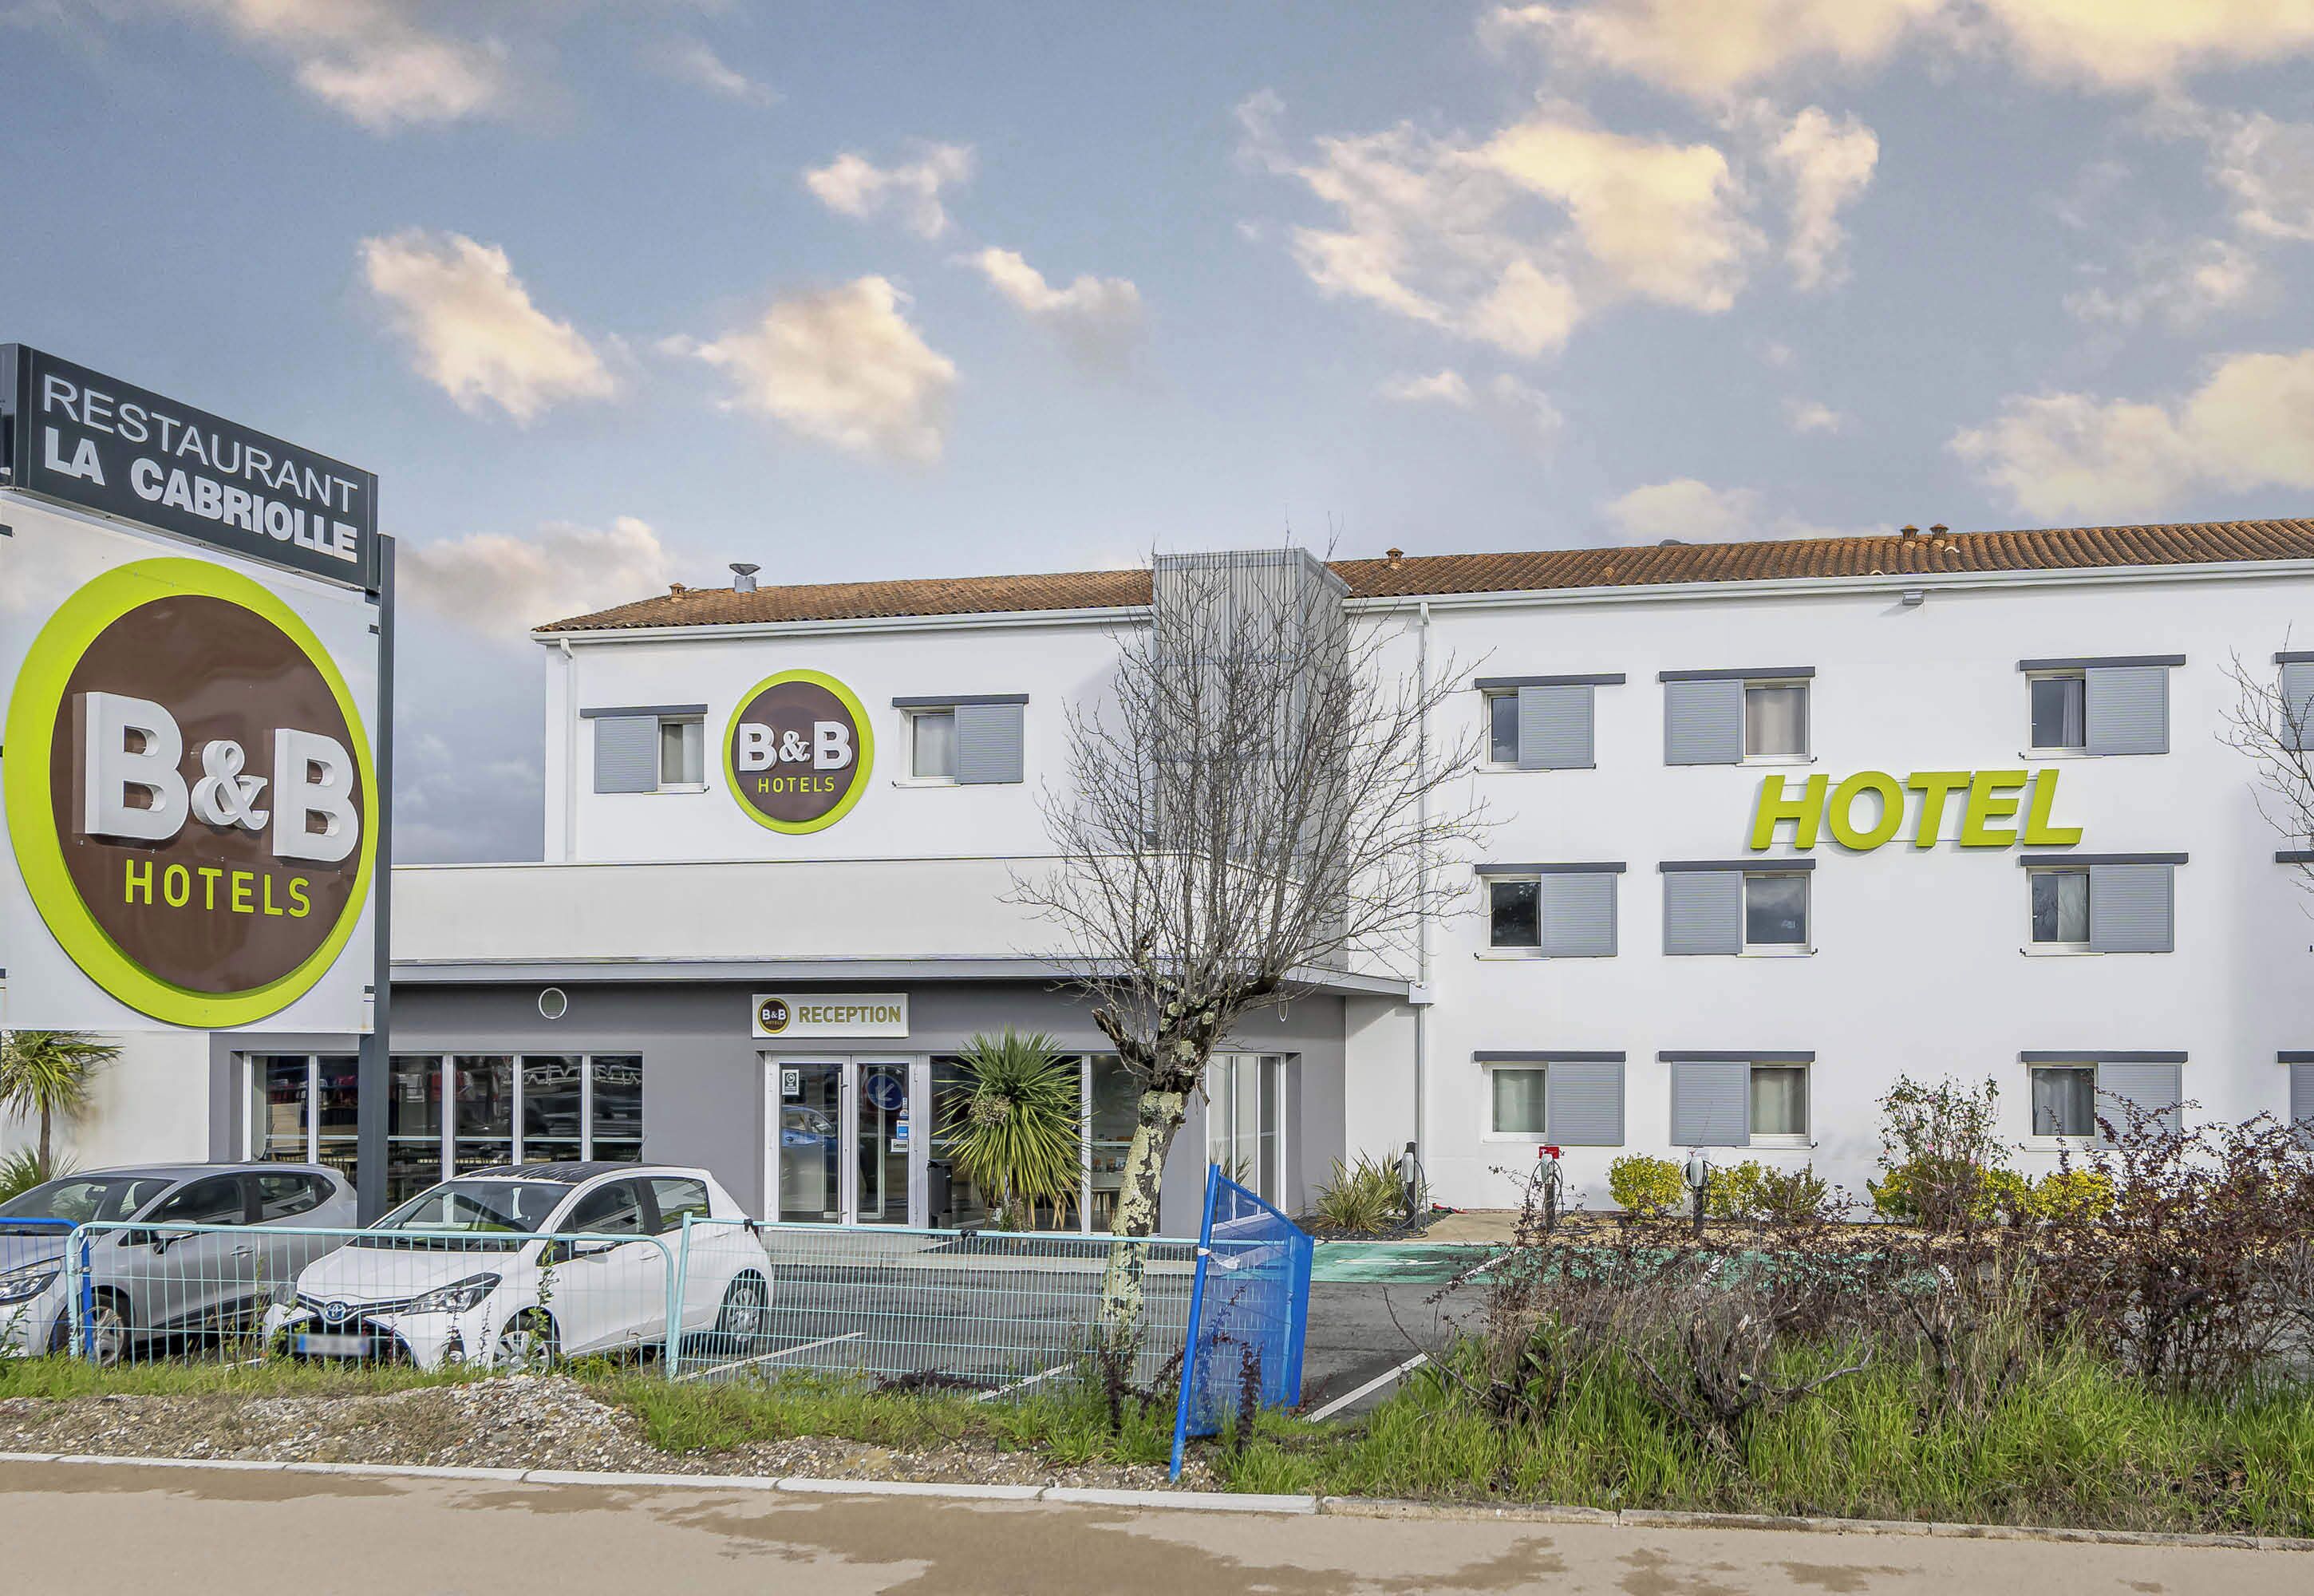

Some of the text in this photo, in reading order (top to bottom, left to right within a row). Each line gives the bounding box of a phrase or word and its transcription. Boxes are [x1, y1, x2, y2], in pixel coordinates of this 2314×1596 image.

[44, 373, 358, 513] RESTAURANT
[45, 426, 358, 563] LA CABRIOLLE
[739, 721, 852, 772] B&B
[85, 691, 359, 863] B&B
[757, 776, 835, 793] HOTELS
[1749, 768, 2084, 851] HOTEL
[124, 859, 311, 918] HOTELS
[762, 1009, 787, 1021] B&B
[798, 1005, 902, 1023] RECEPTION
